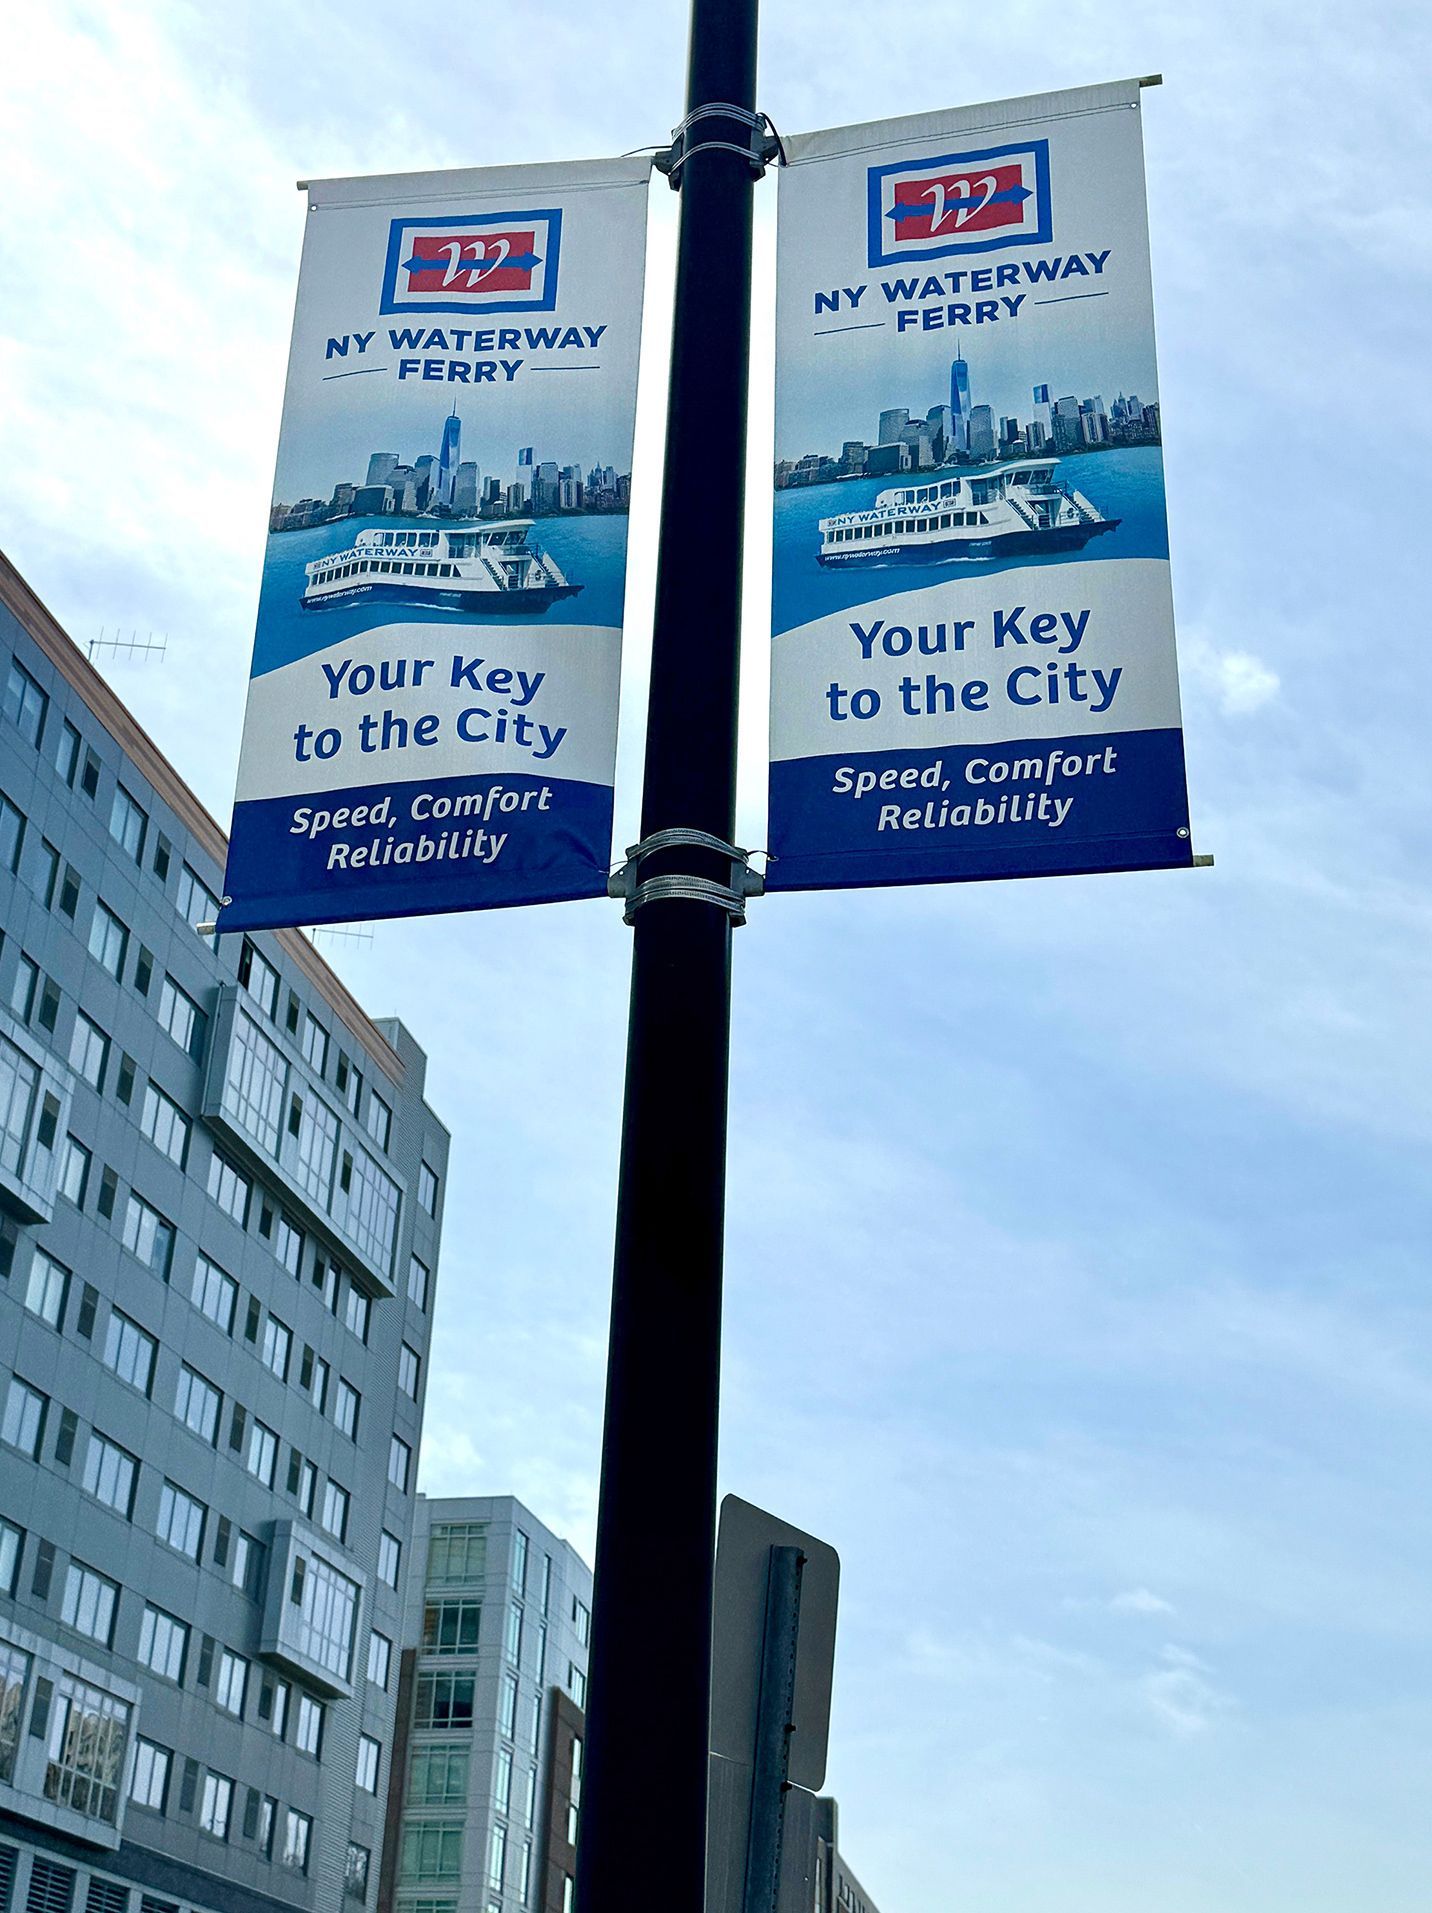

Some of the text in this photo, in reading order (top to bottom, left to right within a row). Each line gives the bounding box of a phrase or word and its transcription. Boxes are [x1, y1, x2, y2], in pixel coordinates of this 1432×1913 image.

[814, 250, 1112, 314] NY WATERWAY
[897, 294, 1027, 332] FERRY
[325, 325, 608, 360] NY WATERWAY
[398, 358, 525, 383] FERRY
[837, 502, 941, 526] NY WATERWAY
[322, 548, 418, 567] NY WATERWAY
[849, 606, 1091, 660] Your Key
[321, 655, 546, 706] Your Key
[826, 662, 1123, 721] to the City
[293, 707, 567, 762] to the City
[832, 746, 1118, 799] Speed, Comfort
[289, 786, 553, 839] Speed, Comfort
[878, 792, 1074, 831] Reliability
[326, 829, 508, 870] Reliability
